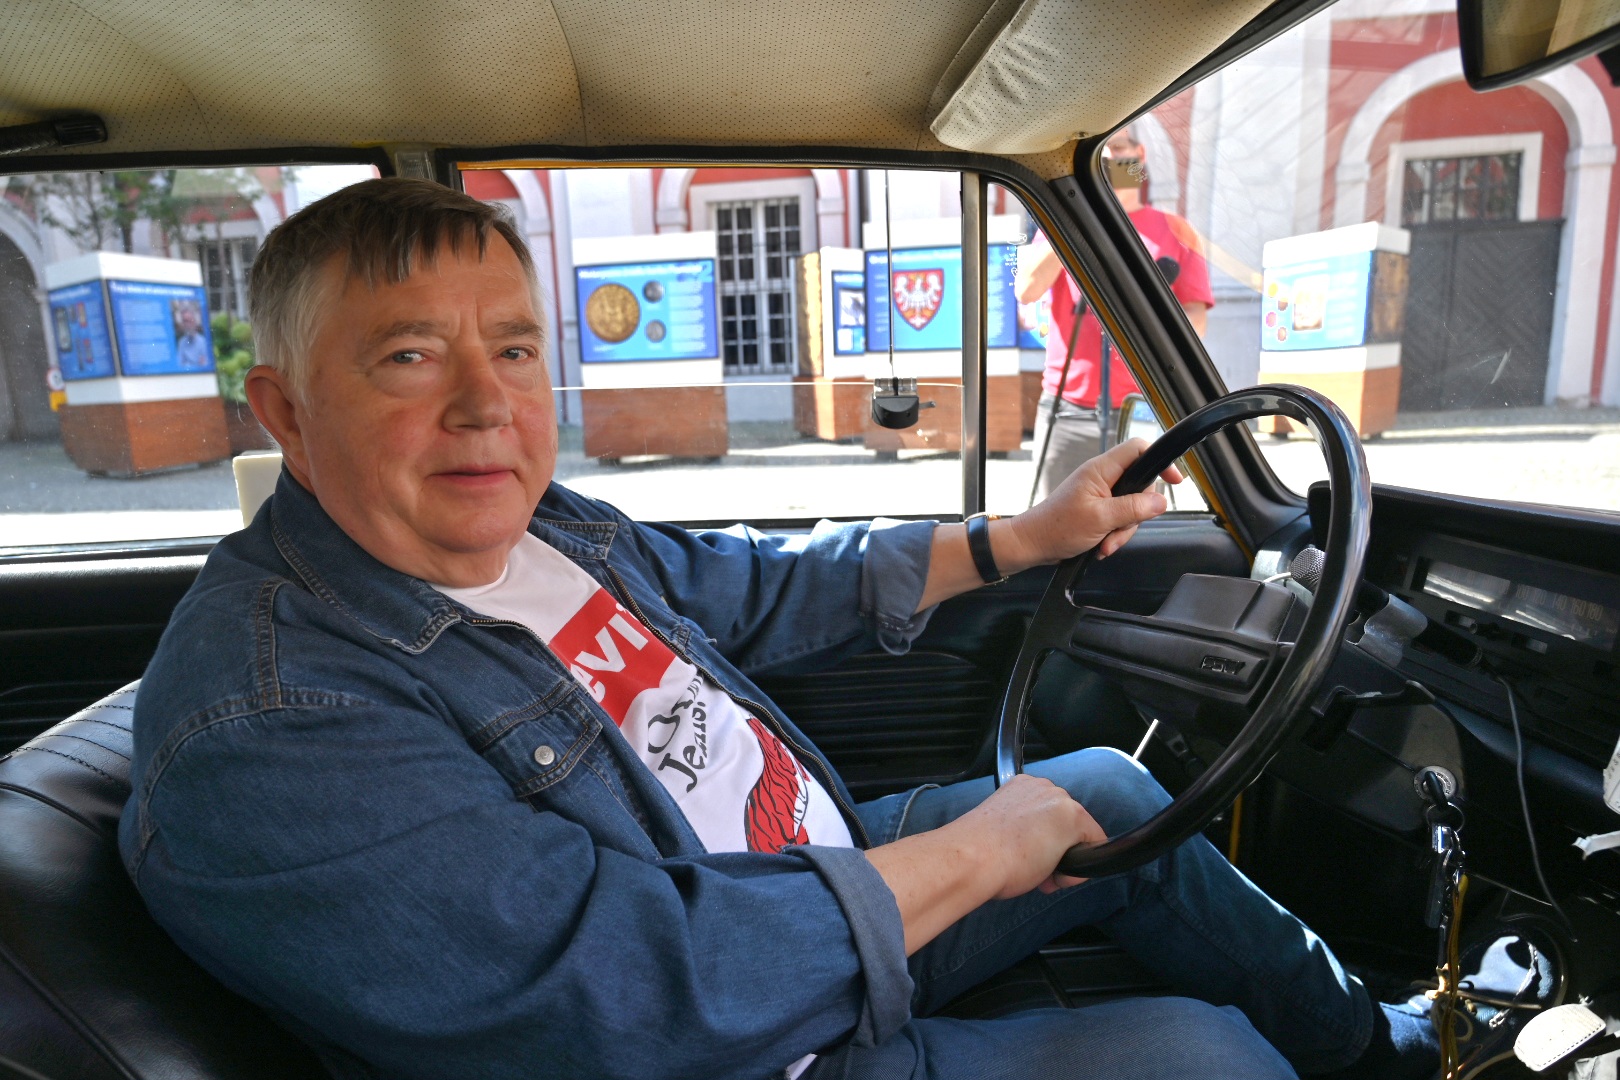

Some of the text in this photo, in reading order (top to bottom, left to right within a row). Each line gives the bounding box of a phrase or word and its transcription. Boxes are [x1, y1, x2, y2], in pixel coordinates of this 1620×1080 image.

[1551, 592, 1568, 611] 140
[1570, 597, 1587, 617] 160
[1586, 602, 1604, 622] 180
